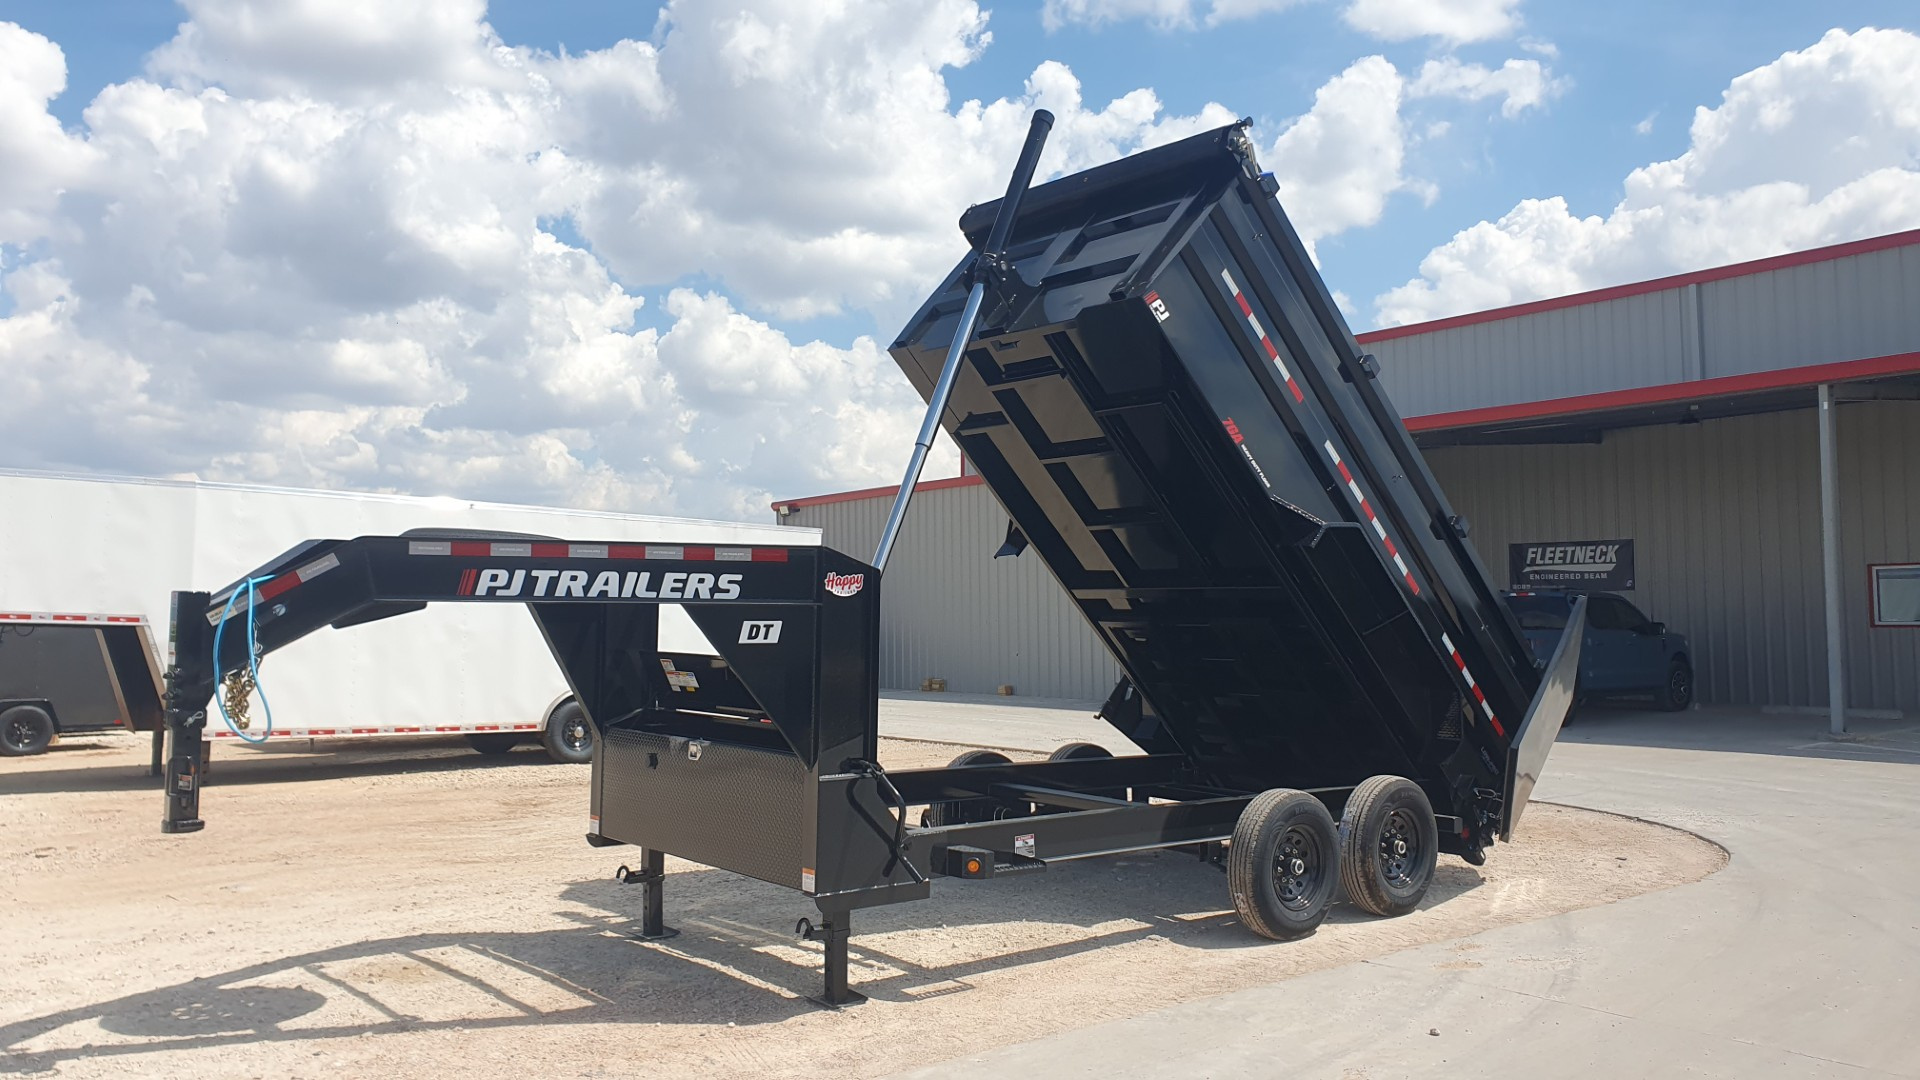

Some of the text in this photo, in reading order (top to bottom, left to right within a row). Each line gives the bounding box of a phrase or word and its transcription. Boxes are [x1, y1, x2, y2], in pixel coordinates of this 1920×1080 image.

[1151, 299, 1170, 321] PJ
[1526, 545, 1619, 564] FLEETNECK
[475, 569, 743, 600] PJ TRAILERS
[826, 573, 863, 590] Happy
[747, 624, 774, 640] DT
